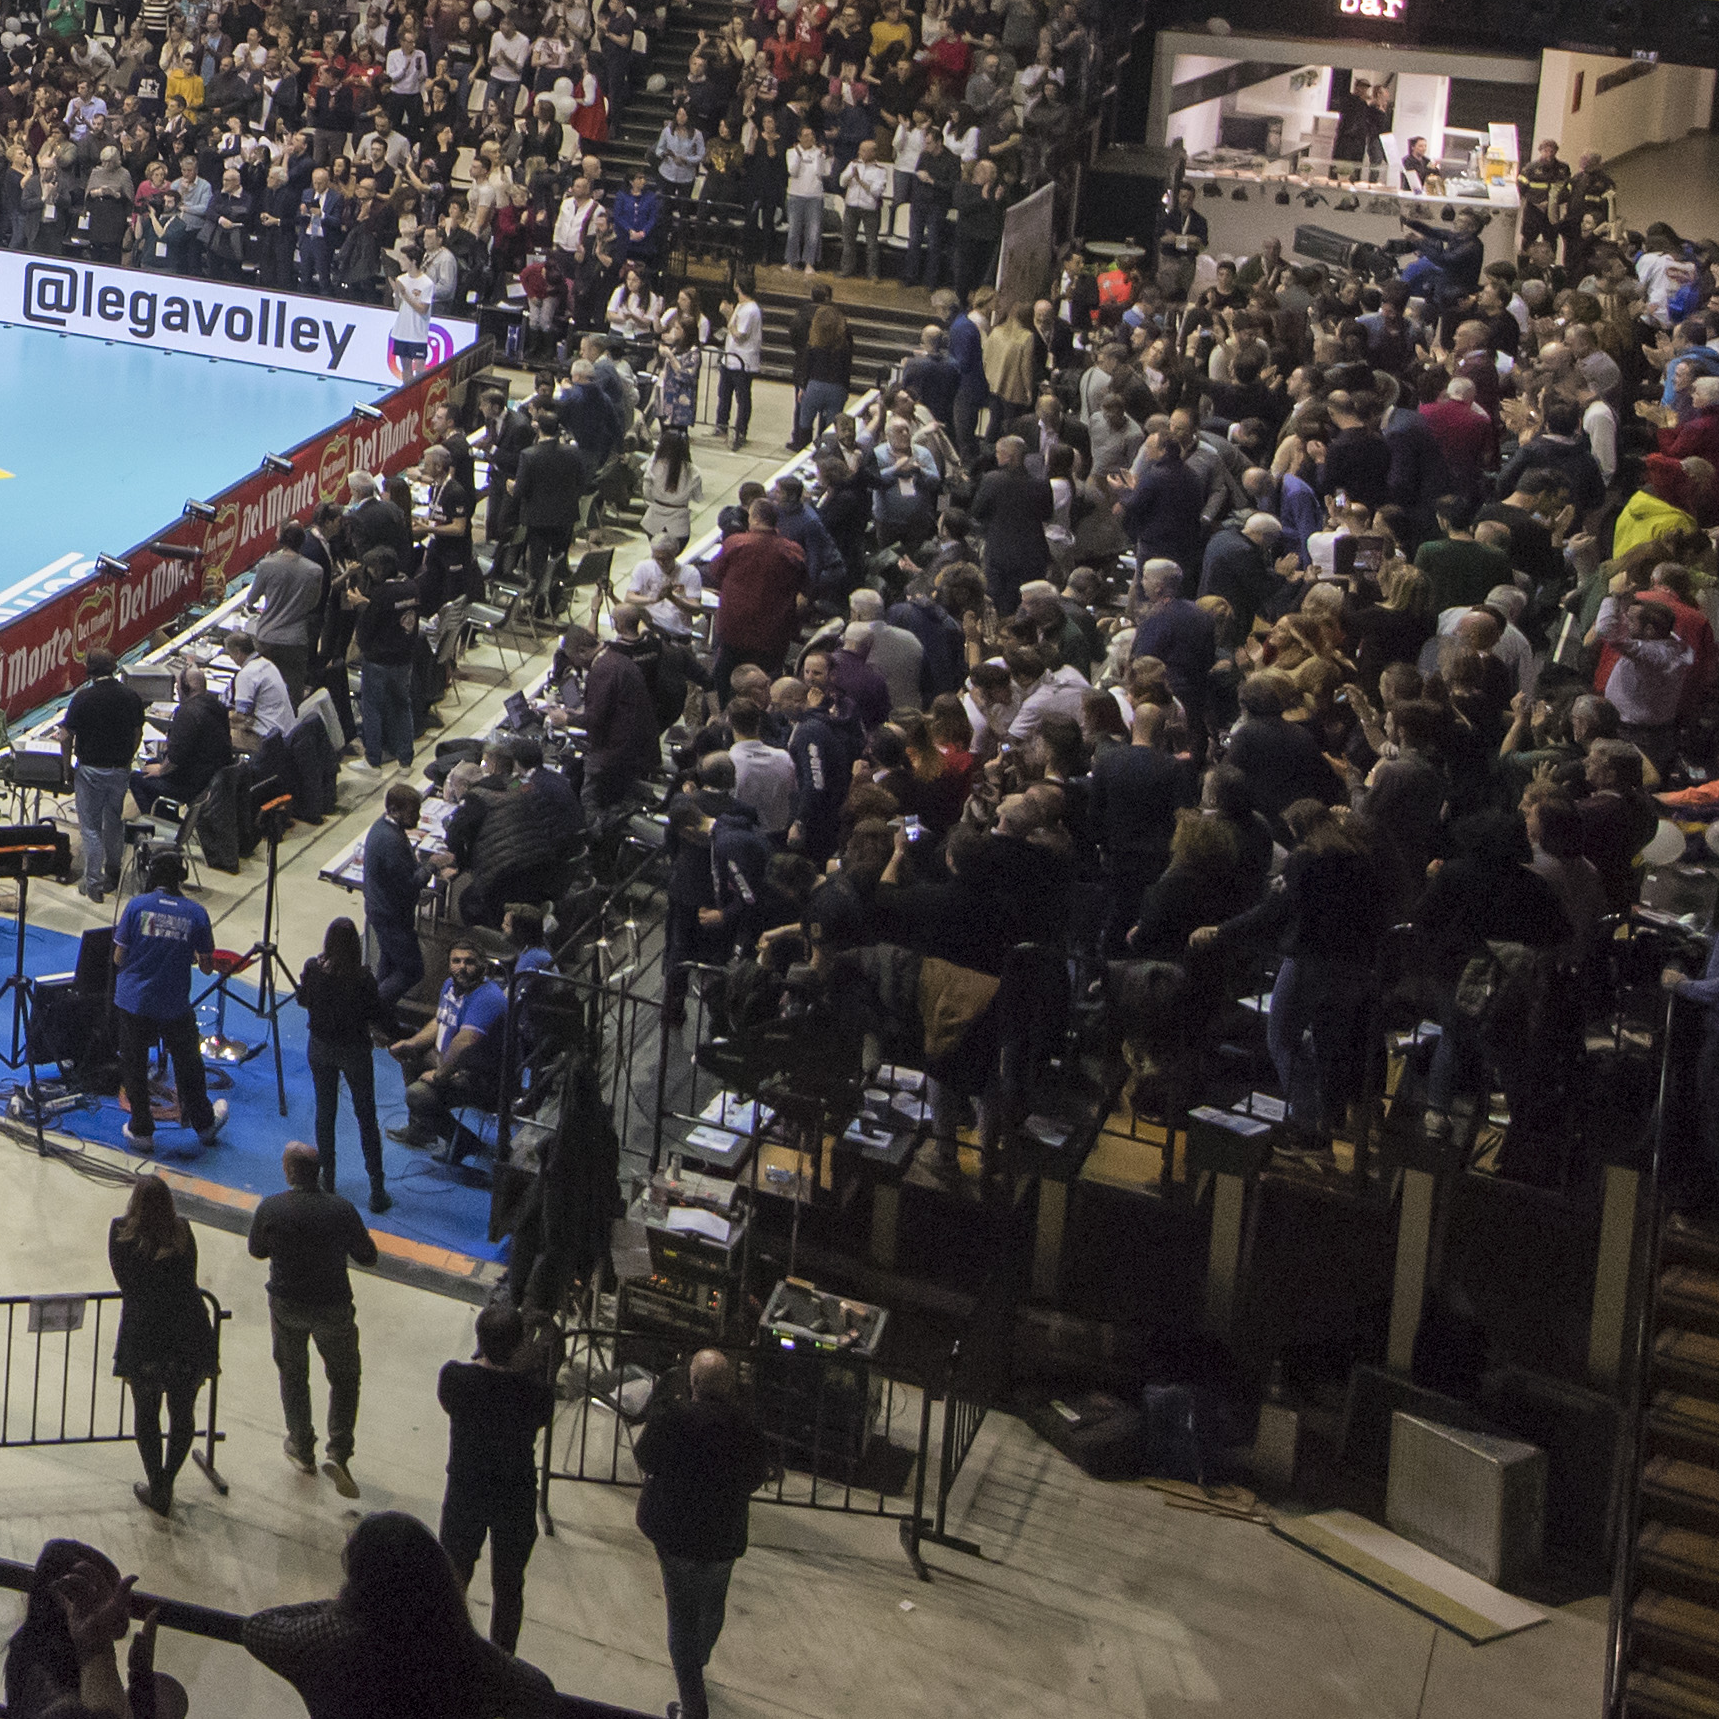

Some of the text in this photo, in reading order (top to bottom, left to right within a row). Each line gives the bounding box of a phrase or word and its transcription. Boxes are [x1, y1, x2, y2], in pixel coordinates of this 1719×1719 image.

[23, 261, 357, 371] @legavolley
[353, 428, 377, 472] Del
[378, 409, 421, 462] Monte
[239, 493, 264, 548] Del
[266, 470, 317, 529] Monte
[118, 572, 147, 631] Del
[5, 625, 72, 699] Monte
